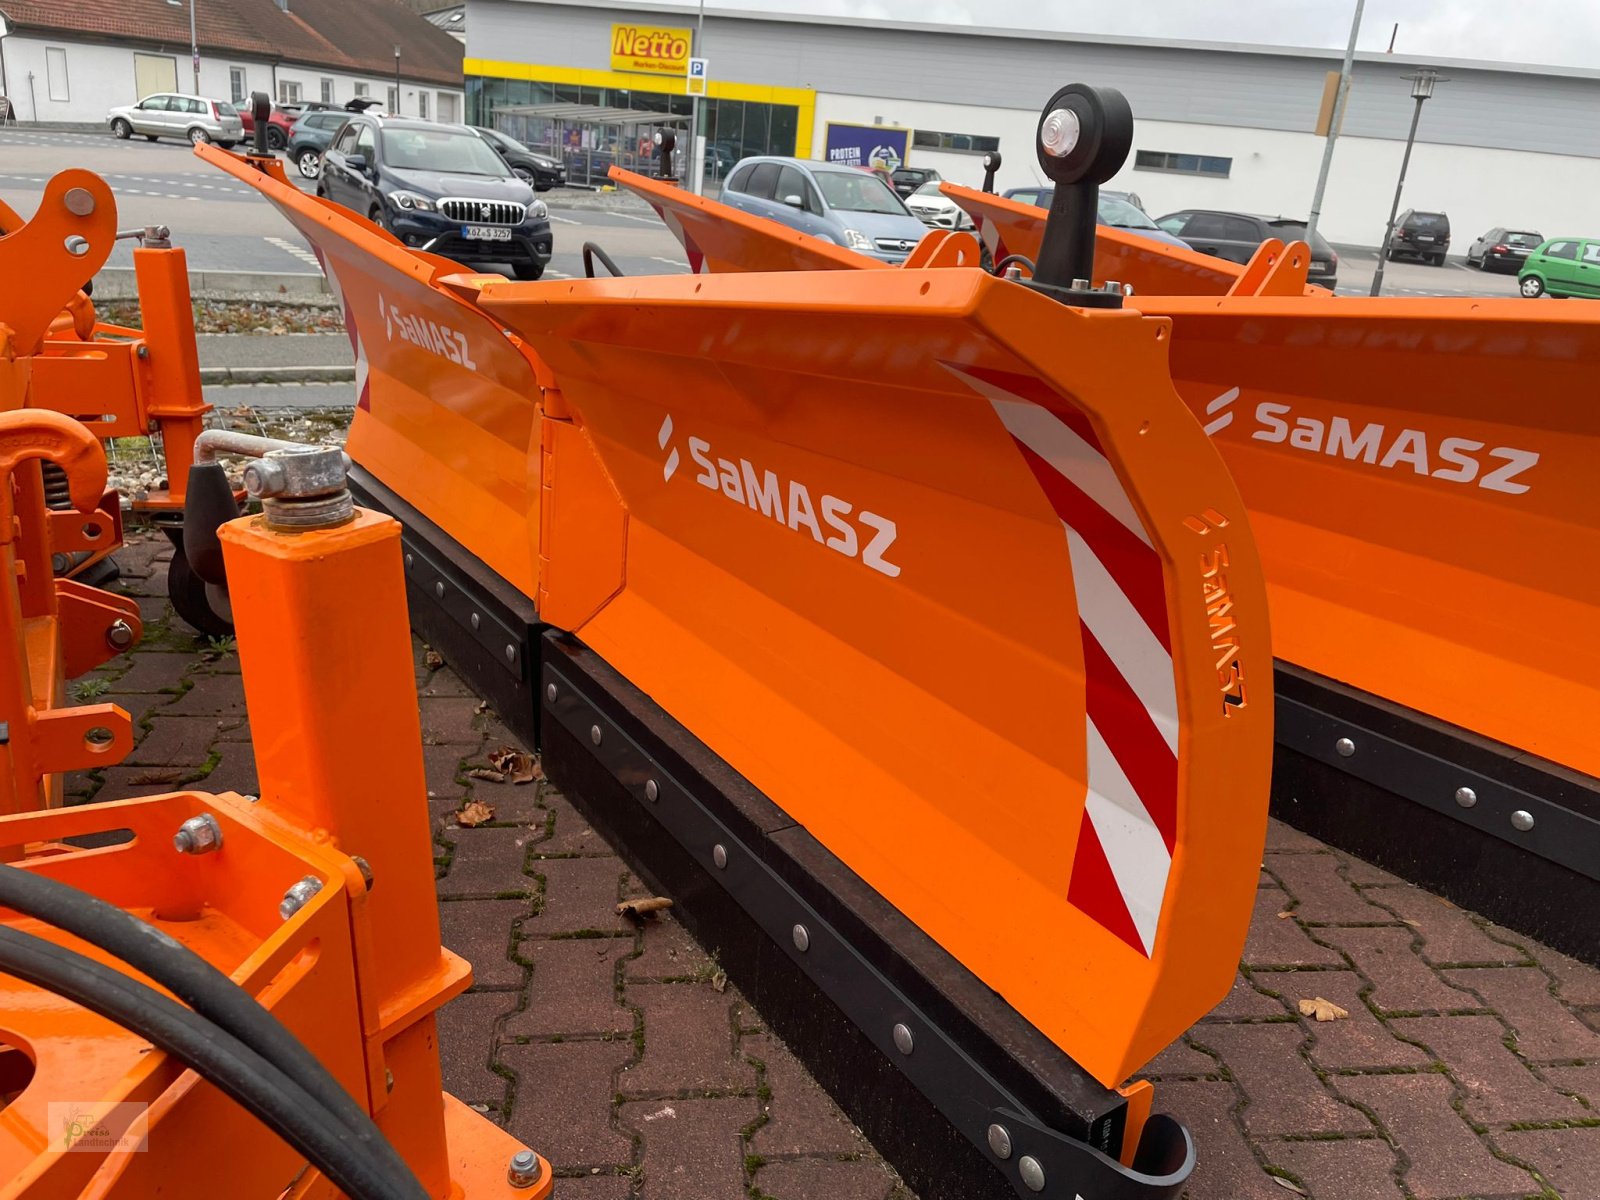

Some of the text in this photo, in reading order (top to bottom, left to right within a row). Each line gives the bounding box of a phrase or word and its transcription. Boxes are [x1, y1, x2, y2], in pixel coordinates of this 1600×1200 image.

[614, 27, 688, 60] Netto
[830, 147, 861, 160] PROTEIN
[390, 304, 476, 371] SaMASZ
[1251, 402, 1540, 495] SaMASZ
[688, 435, 901, 578] SaMASZ
